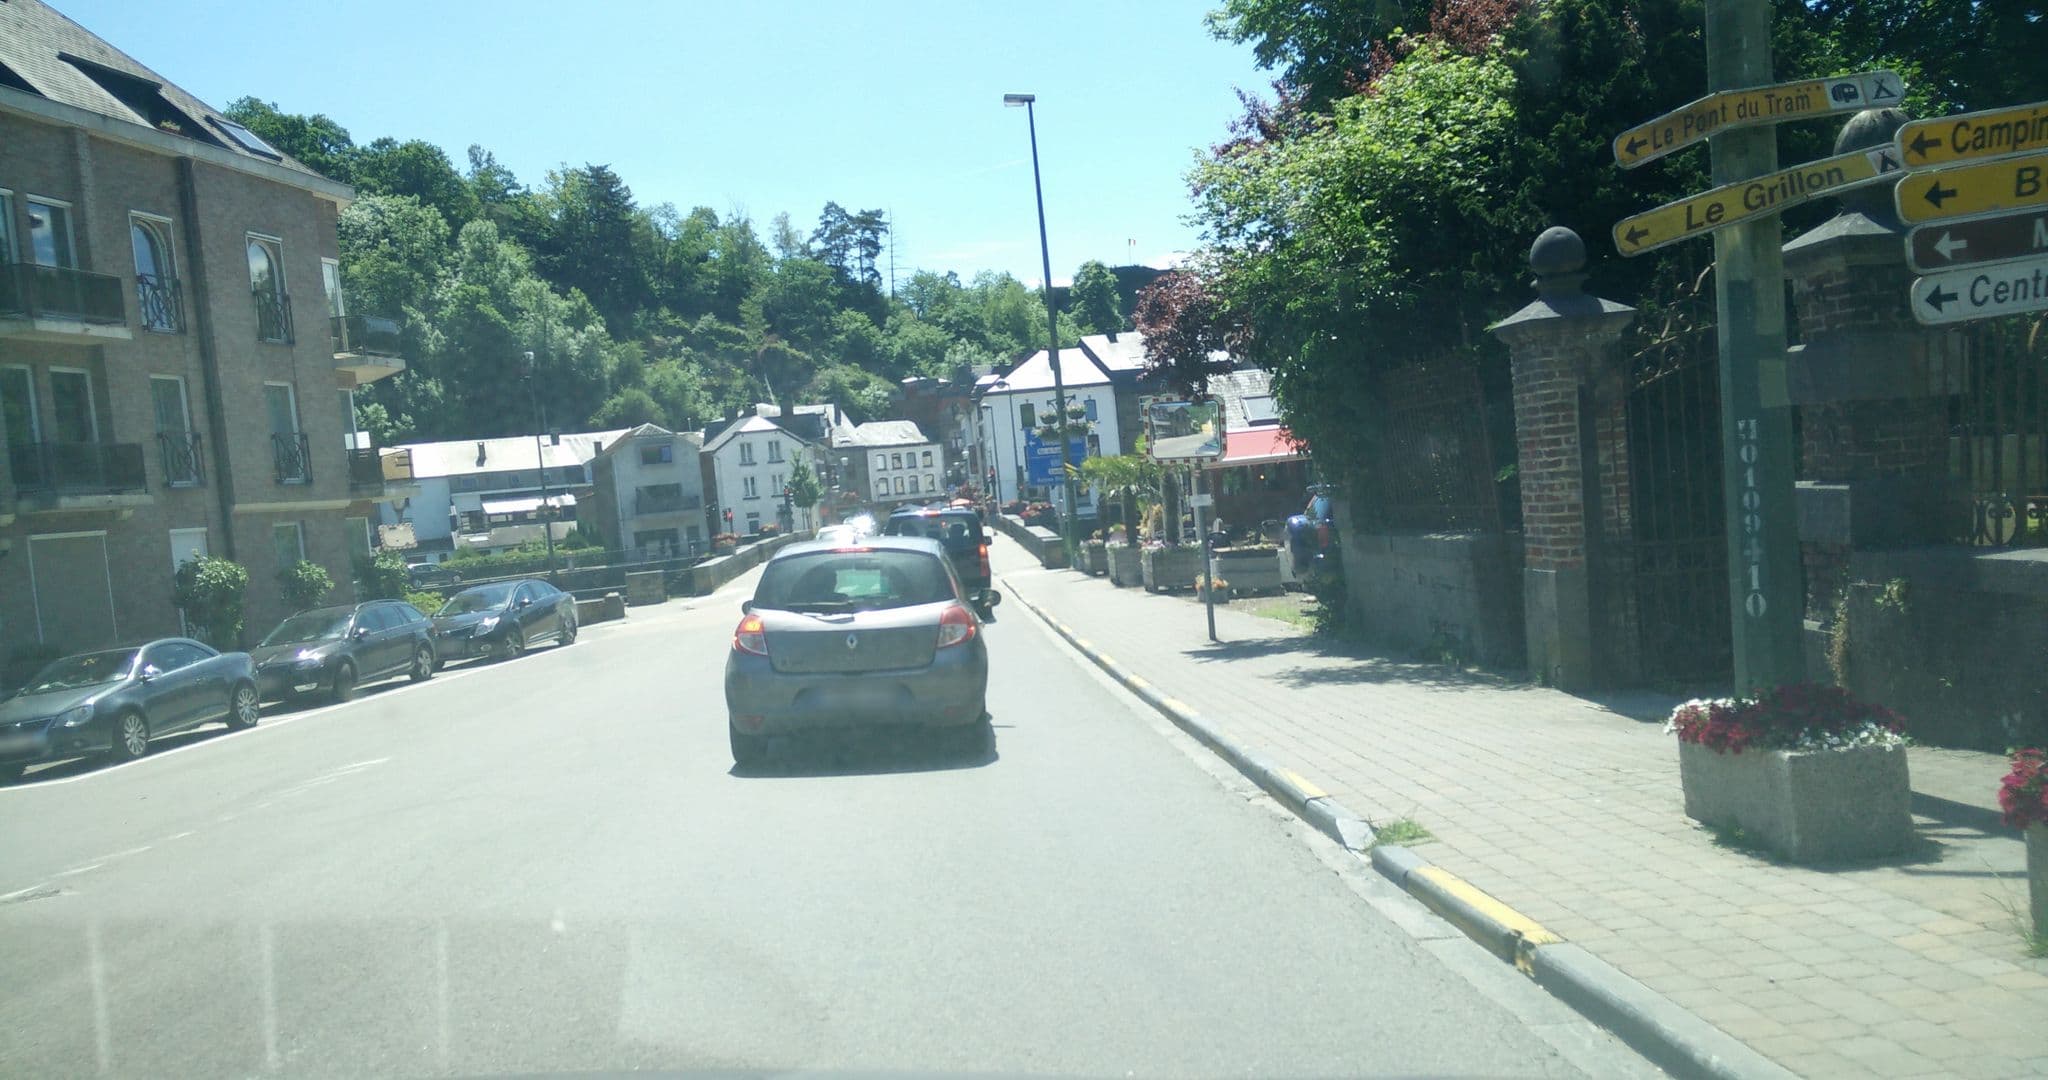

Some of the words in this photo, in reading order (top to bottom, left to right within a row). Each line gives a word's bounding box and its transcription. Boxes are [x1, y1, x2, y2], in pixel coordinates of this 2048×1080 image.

[1652, 127, 1674, 150] Le
[1684, 107, 1728, 138] Pont
[1737, 98, 1760, 119] du
[1765, 93, 1811, 115] Tram
[1686, 201, 1725, 230] Le
[1743, 166, 1845, 211] Grillon
[2016, 166, 2048, 198] B
